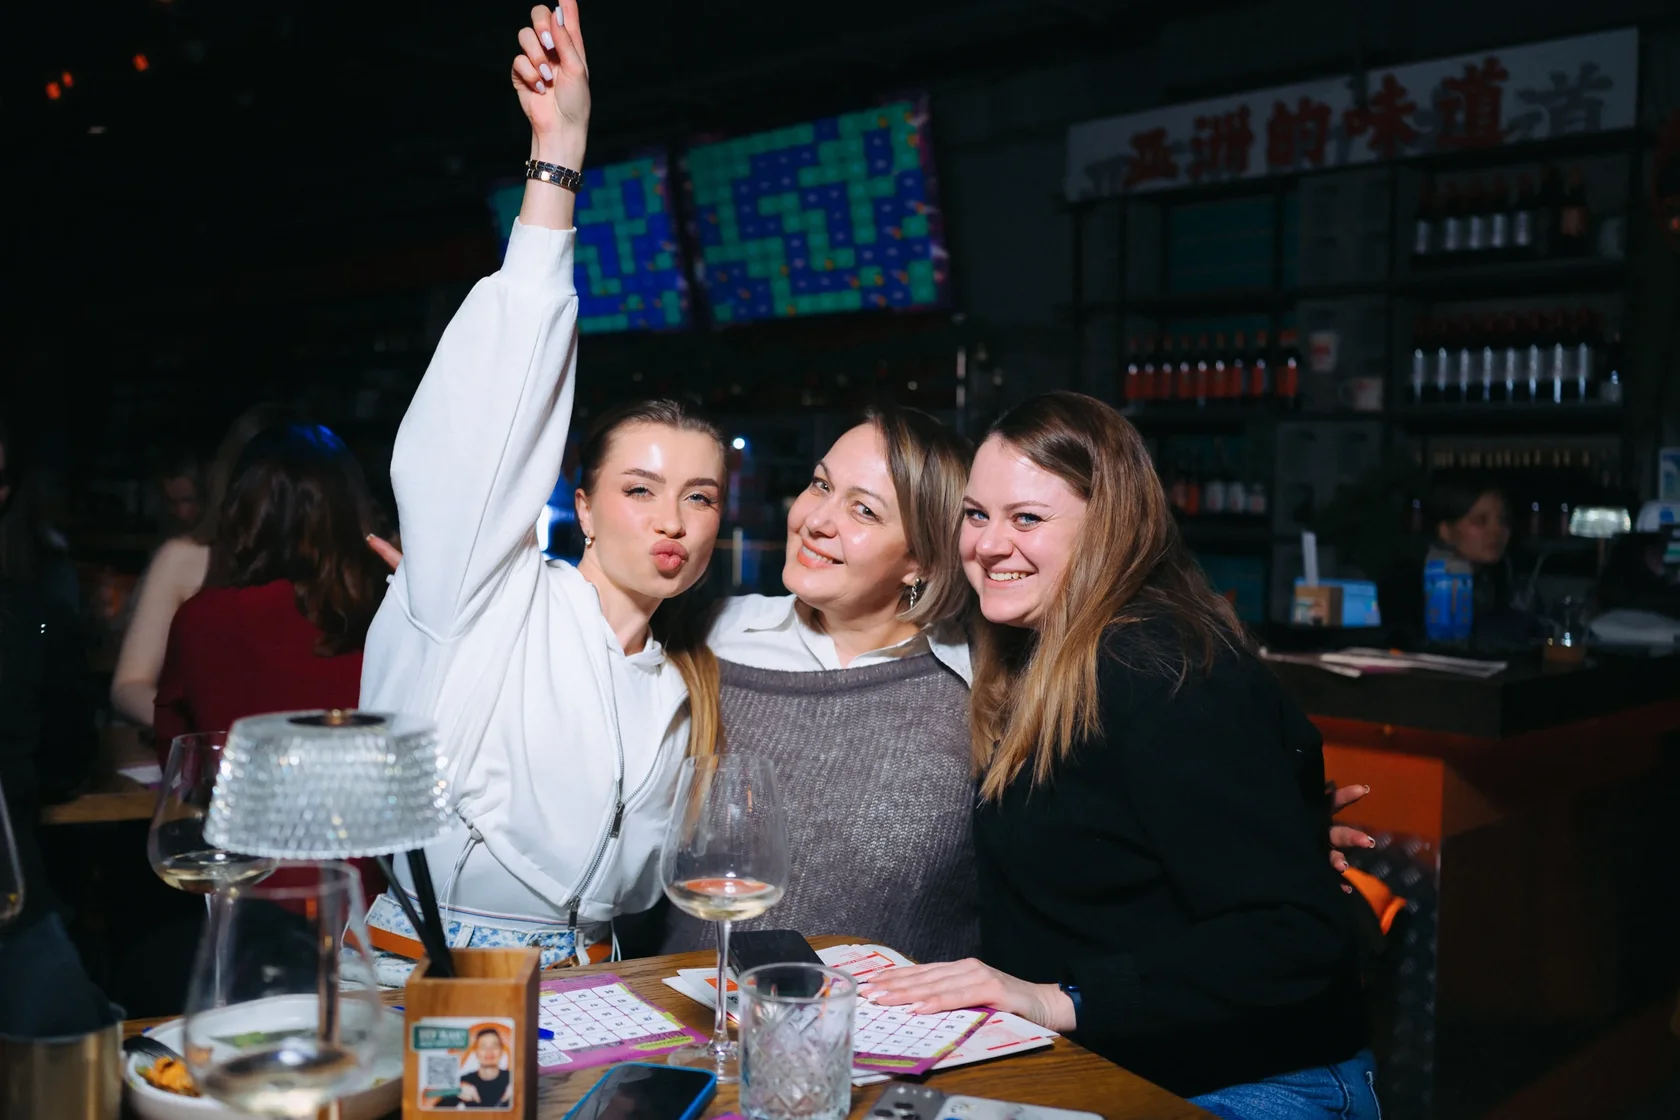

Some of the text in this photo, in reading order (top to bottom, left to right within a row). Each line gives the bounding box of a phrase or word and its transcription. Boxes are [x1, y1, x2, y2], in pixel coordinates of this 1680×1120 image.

[1123, 57, 1508, 189] 亚洲的味道
